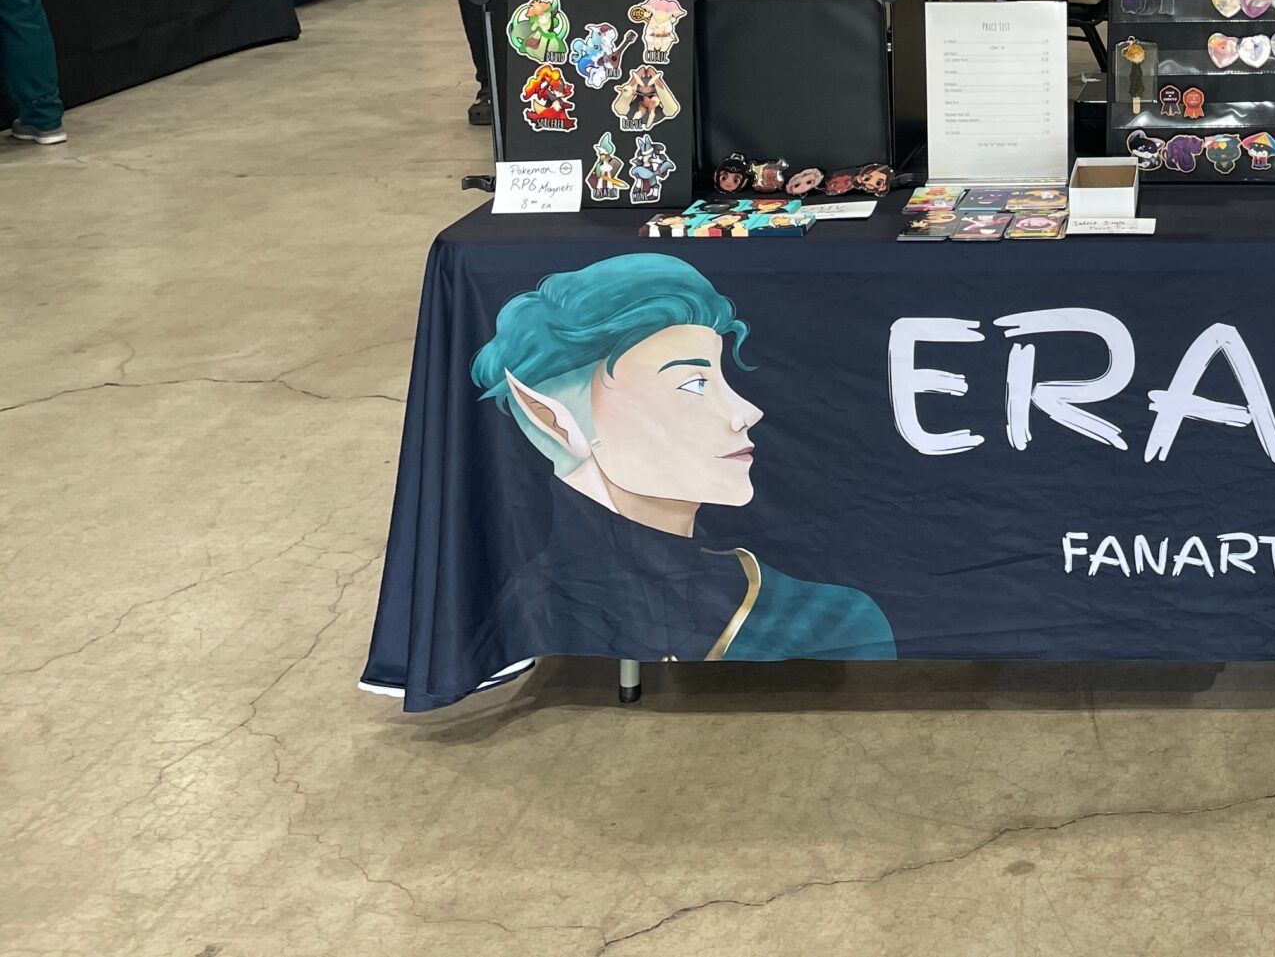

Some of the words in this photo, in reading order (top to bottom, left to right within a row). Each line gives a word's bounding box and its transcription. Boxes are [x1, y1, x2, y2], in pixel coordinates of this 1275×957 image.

[982, 22, 997, 32] PRICE
[999, 22, 1010, 31] LIST
[510, 164, 554, 175] Pokemon
[538, 181, 574, 198] Magnets
